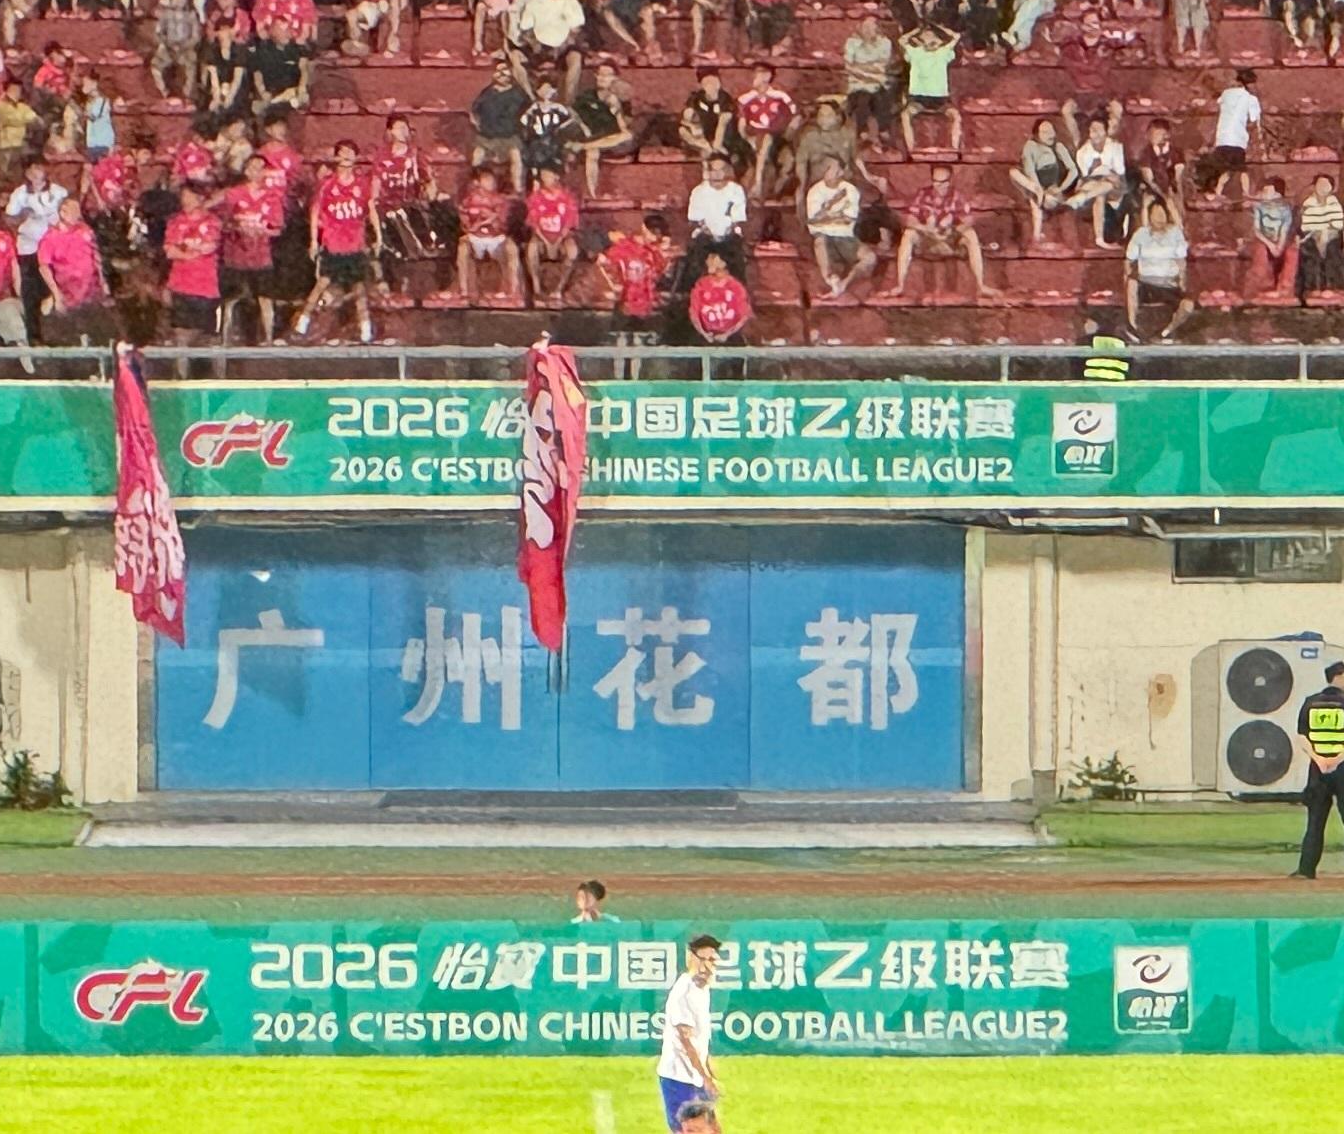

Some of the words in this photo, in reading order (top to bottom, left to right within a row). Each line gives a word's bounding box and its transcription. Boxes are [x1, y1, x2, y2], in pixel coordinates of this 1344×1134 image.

[327, 397, 469, 439] 2026
[331, 457, 402, 482] 2026
[411, 457, 526, 482] C'ESTB
[583, 457, 699, 482] HINESE
[707, 457, 868, 483] FOOTBALL
[876, 456, 1013, 482] LEAGUE2
[203, 606, 919, 731] 广州花都
[251, 943, 418, 990] 2026
[254, 1012, 338, 1042] 2026
[349, 1011, 528, 1042] C'ESTBON
[539, 1011, 665, 1042] CHINES
[904, 1010, 1068, 1042] LEAGUE2
